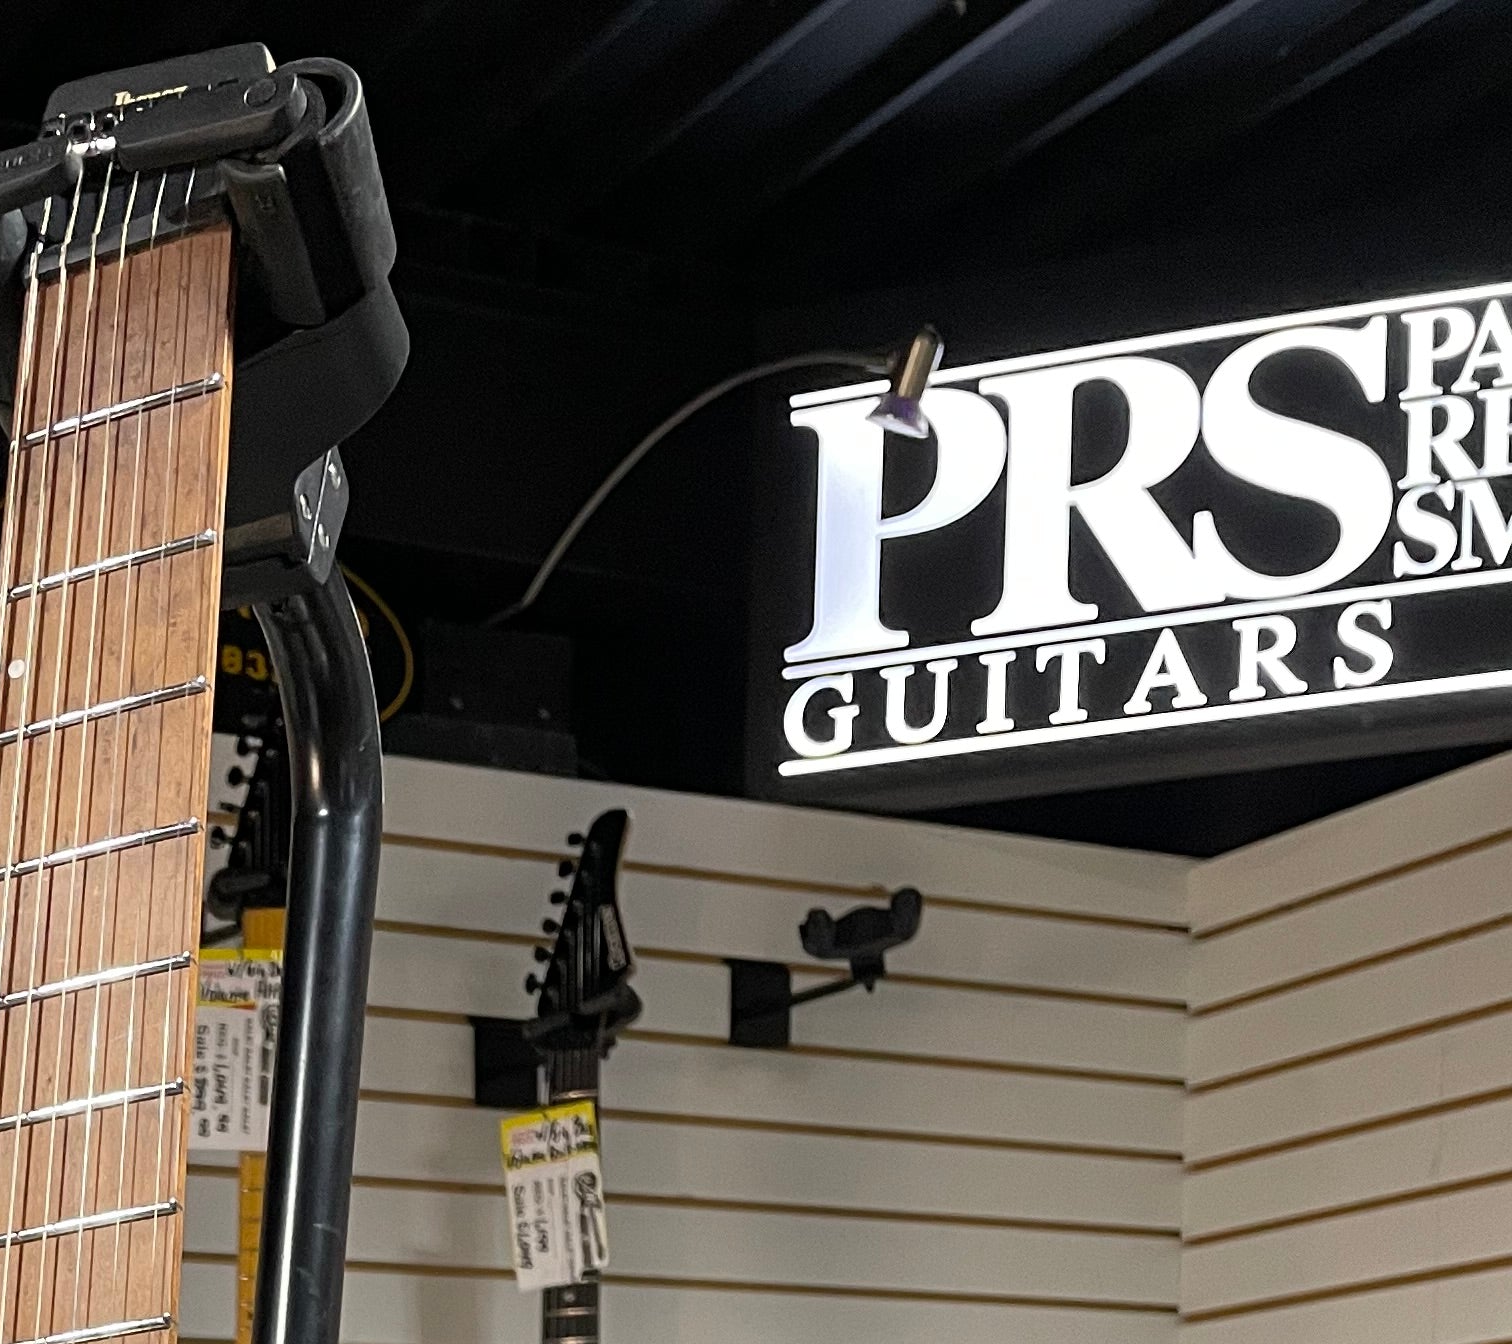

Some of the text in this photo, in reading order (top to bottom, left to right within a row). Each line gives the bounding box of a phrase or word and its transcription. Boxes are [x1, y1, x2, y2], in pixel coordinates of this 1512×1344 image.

[1398, 298, 1512, 401] PA
[784, 315, 1394, 662] PRS
[1393, 479, 1512, 579] SM
[782, 600, 1395, 759] GUITARS
